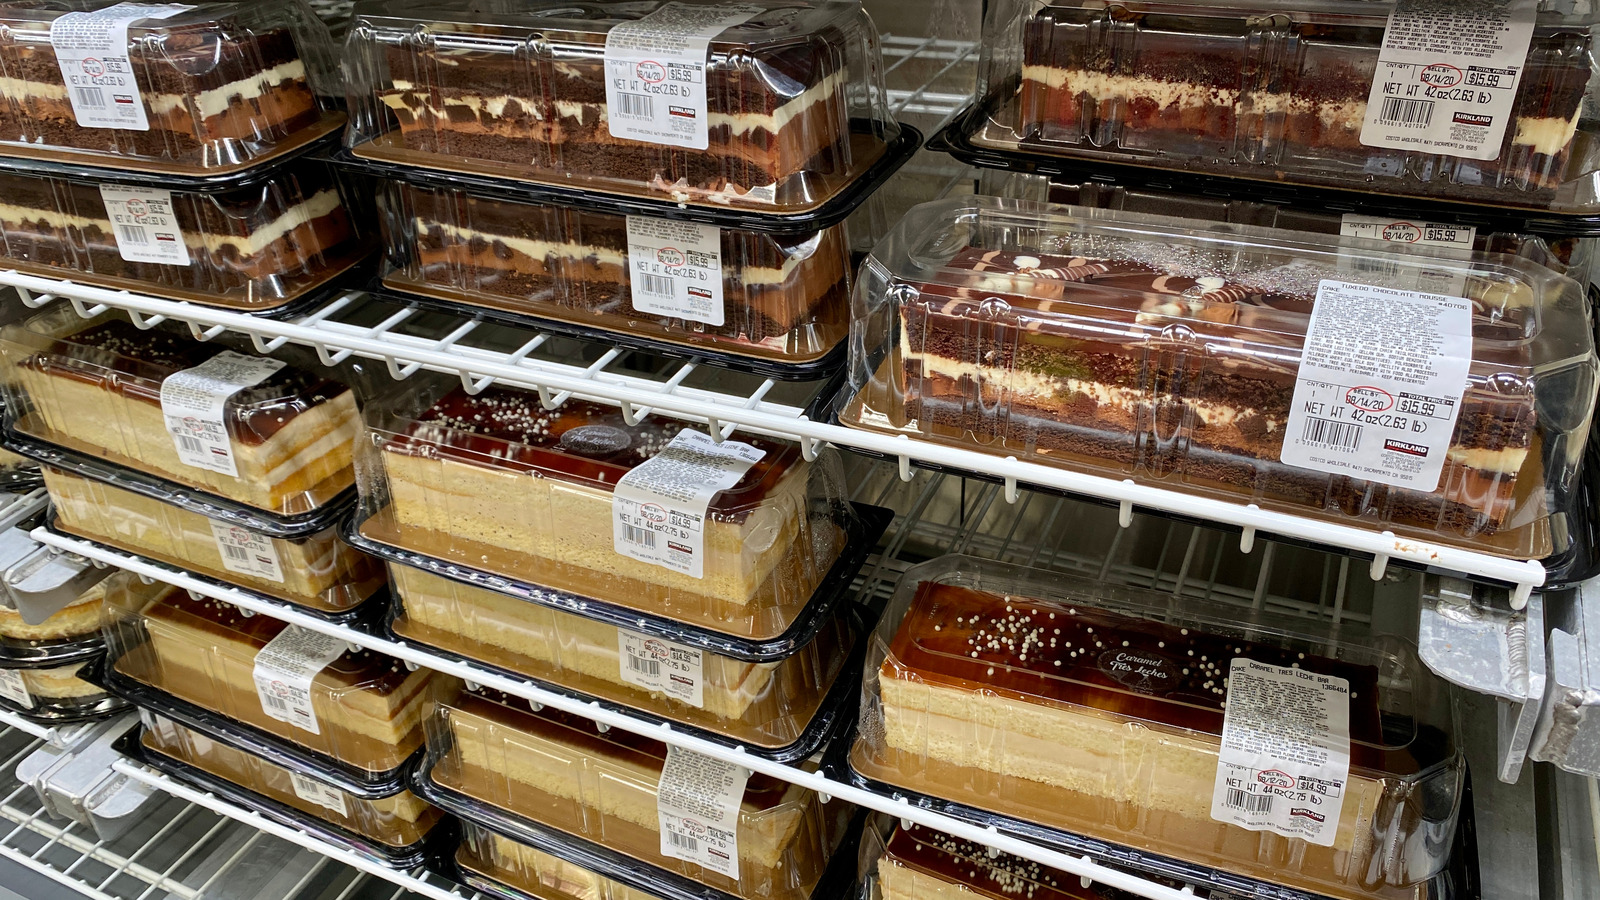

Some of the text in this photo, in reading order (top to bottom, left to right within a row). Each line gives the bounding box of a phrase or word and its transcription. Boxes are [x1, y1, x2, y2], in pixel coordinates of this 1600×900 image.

[671, 69, 691, 81] $15.99
[1421, 73, 1454, 85] 08/14/20
[1469, 73, 1500, 87] $15.99
[614, 79, 626, 89] NET
[630, 81, 638, 91] WT
[643, 82, 651, 93] 42
[1383, 82, 1402, 94] NET
[1406, 85, 1420, 96] WT
[1425, 86, 1437, 98] 42
[1455, 113, 1490, 123] KIRKLAND
[1383, 231, 1413, 241] 08/14/20
[1428, 230, 1456, 241] $15.99
[1372, 288, 1415, 298] CHOCOLATE
[1345, 395, 1384, 410] 08/14/20
[1407, 393, 1426, 402] TOTAL
[1427, 396, 1445, 404] PRICE
[1304, 401, 1327, 415] NET
[1331, 406, 1345, 419] WT
[1351, 409, 1365, 422] 42
[1401, 401, 1436, 416] $15.99
[1386, 440, 1427, 453] KIRKLAND
[1326, 459, 1350, 468] WHOLESALE
[620, 513, 631, 522] NET
[634, 518, 642, 526] WT
[646, 521, 653, 529] 44
[672, 516, 690, 529] $14.99
[1116, 652, 1162, 667] Caramel
[1134, 666, 1168, 679] Leches
[1250, 662, 1274, 674] CARAMEL
[1296, 671, 1314, 681] LECHE
[1226, 778, 1242, 787] NET
[1247, 784, 1258, 792] WT
[1258, 776, 1287, 787] 08/12/20
[1300, 782, 1327, 794] $14.99
[1292, 809, 1324, 819] KIRKLAND
